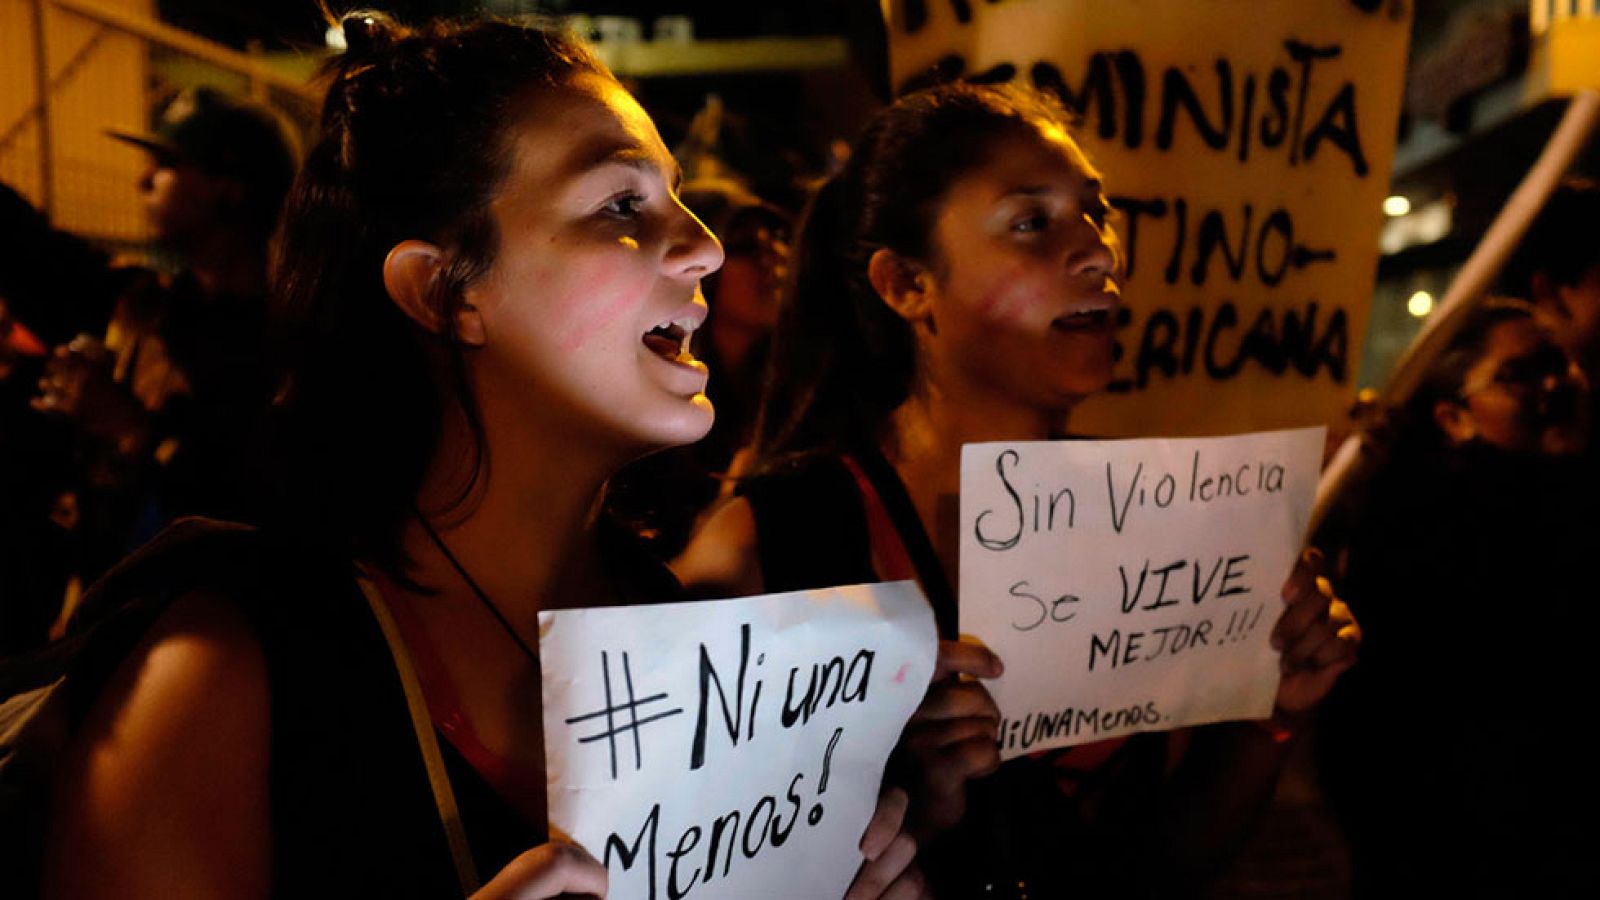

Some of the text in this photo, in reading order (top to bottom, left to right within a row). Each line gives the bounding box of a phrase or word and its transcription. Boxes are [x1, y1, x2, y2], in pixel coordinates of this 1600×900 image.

[900, 40, 1369, 177] MINISTA
[1107, 196, 1336, 287] TINO-
[1106, 302, 1347, 392] RICANA
[975, 449, 1286, 551] Sin Violencia
[1119, 555, 1251, 614] VIVE
[781, 648, 876, 729] una
[603, 727, 844, 900] Menos!
